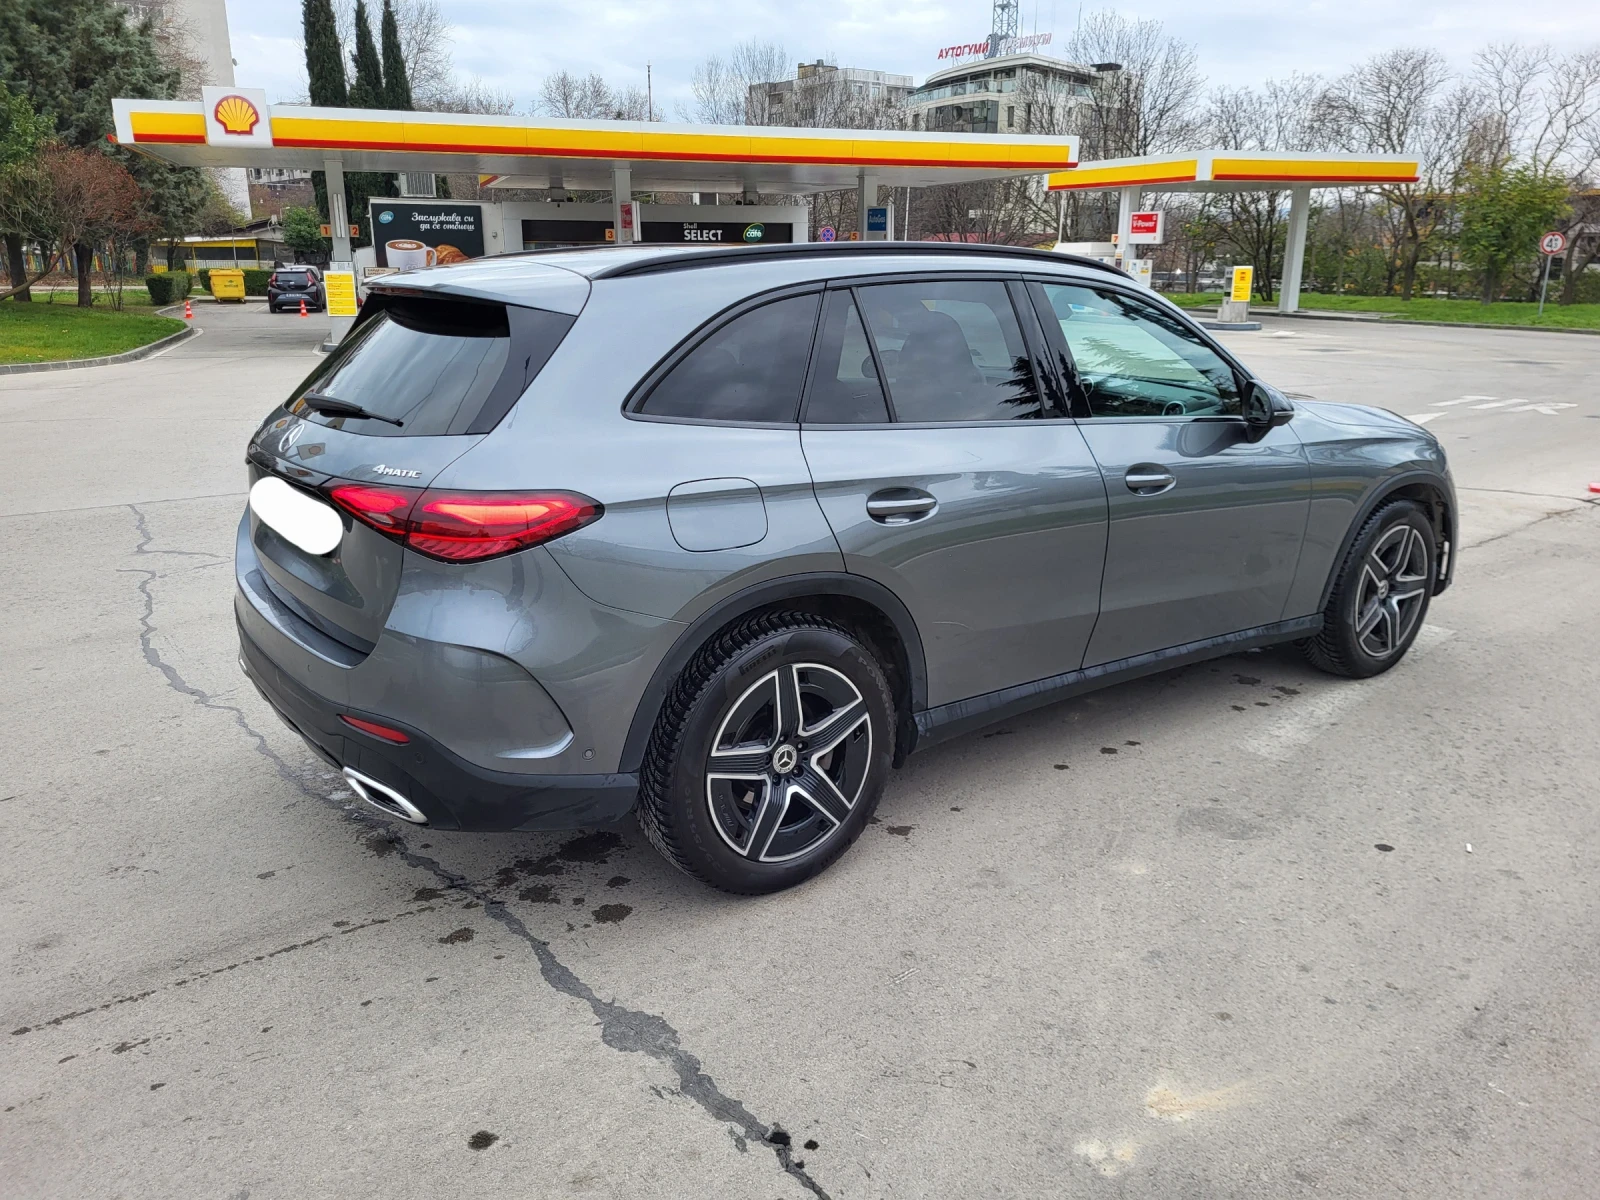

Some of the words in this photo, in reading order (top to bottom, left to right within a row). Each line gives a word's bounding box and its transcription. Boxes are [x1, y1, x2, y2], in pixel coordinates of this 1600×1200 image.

[411, 212, 462, 224] Заслужава
[323, 227, 329, 235] 1
[352, 227, 358, 235] 2
[607, 230, 613, 239] 3
[684, 230, 722, 241] SELECT
[373, 464, 422, 478] 4MATIC
